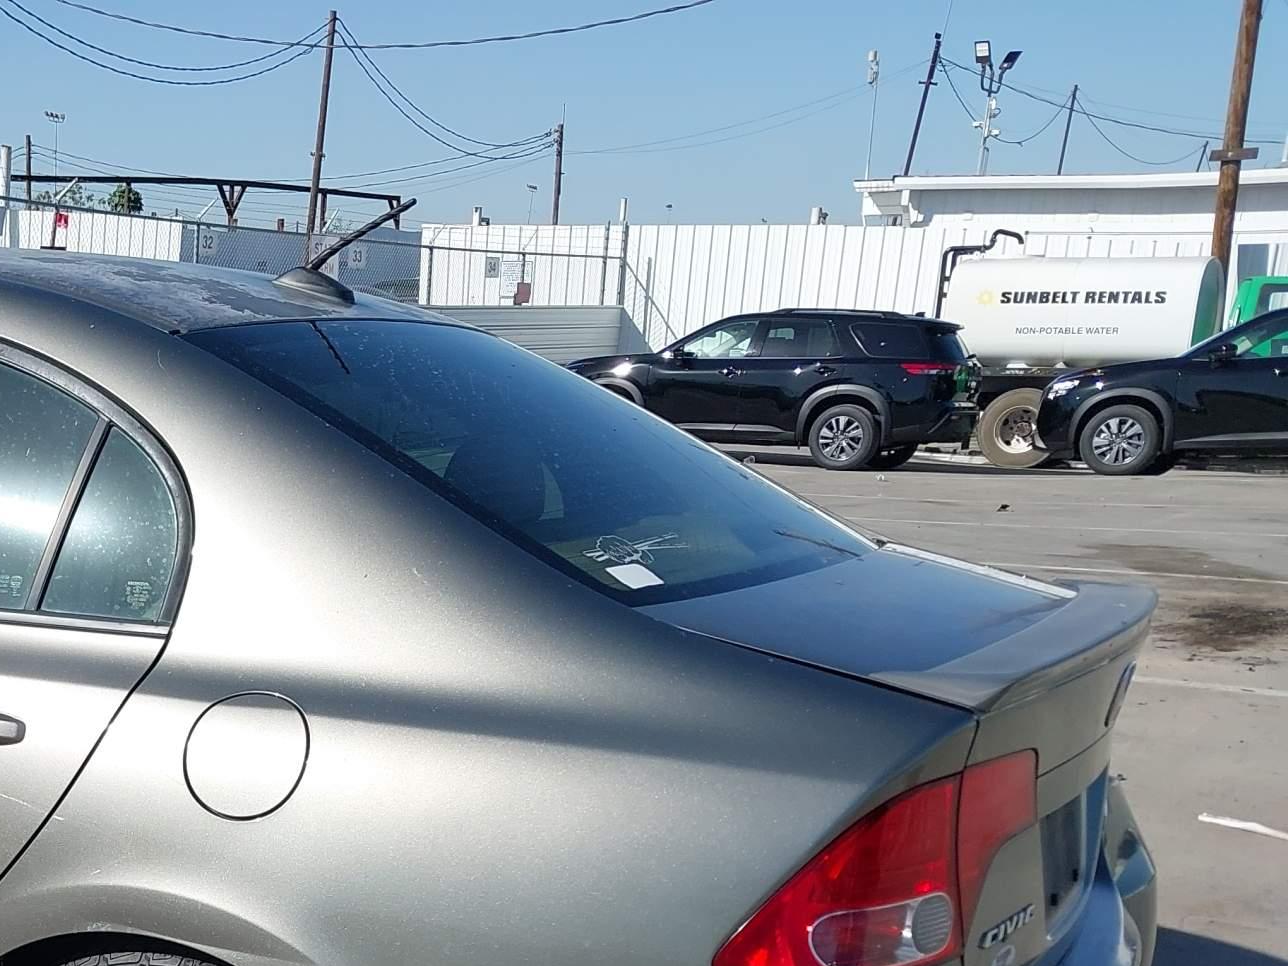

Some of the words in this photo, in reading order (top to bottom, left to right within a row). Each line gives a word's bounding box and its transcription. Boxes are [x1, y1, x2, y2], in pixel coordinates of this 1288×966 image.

[202, 236, 213, 249] 32
[353, 250, 362, 262] 33
[999, 291, 1080, 304] SUNBELT
[1084, 291, 1167, 304] RENTALS
[1015, 327, 1083, 335] NON-POTABLE
[1085, 327, 1119, 335] WATER
